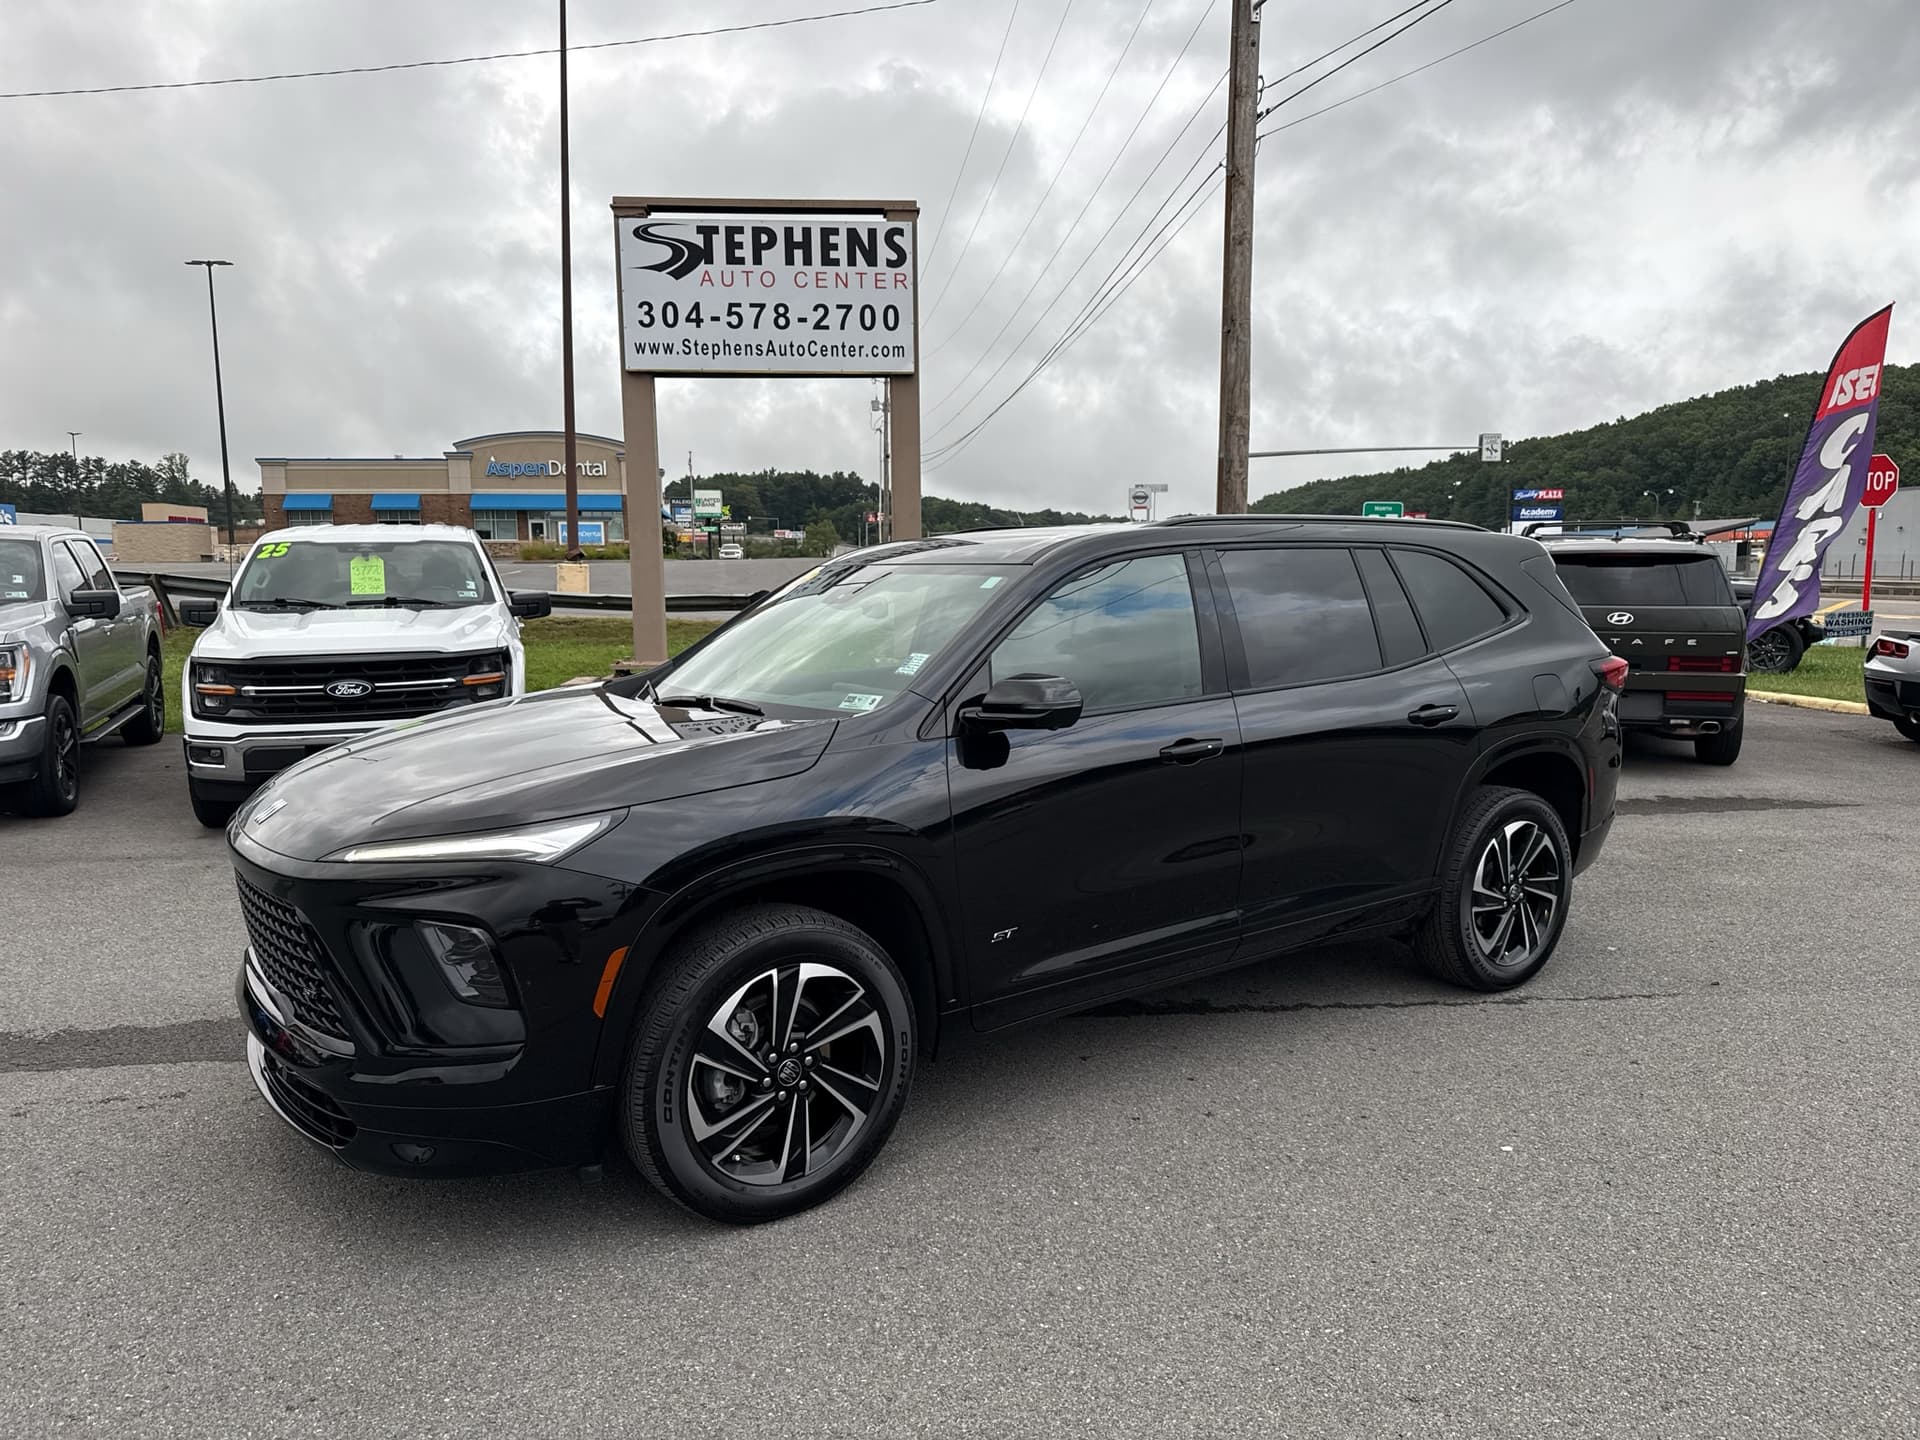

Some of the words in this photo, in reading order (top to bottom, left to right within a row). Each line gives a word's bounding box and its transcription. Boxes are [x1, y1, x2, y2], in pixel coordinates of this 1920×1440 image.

[628, 223, 908, 280] STEPHENS
[700, 270, 776, 288] AUTO
[793, 271, 908, 289] CENTER
[637, 301, 900, 331] 304-578-2700
[634, 338, 905, 360] www.StephensAutoCenter.com
[1867, 470, 1896, 492] TOP
[1538, 490, 1563, 499] PLAZA
[1520, 508, 1558, 517] Academy
[257, 542, 291, 559] 25
[1825, 617, 1873, 628] WASHING
[335, 684, 362, 695] Ford
